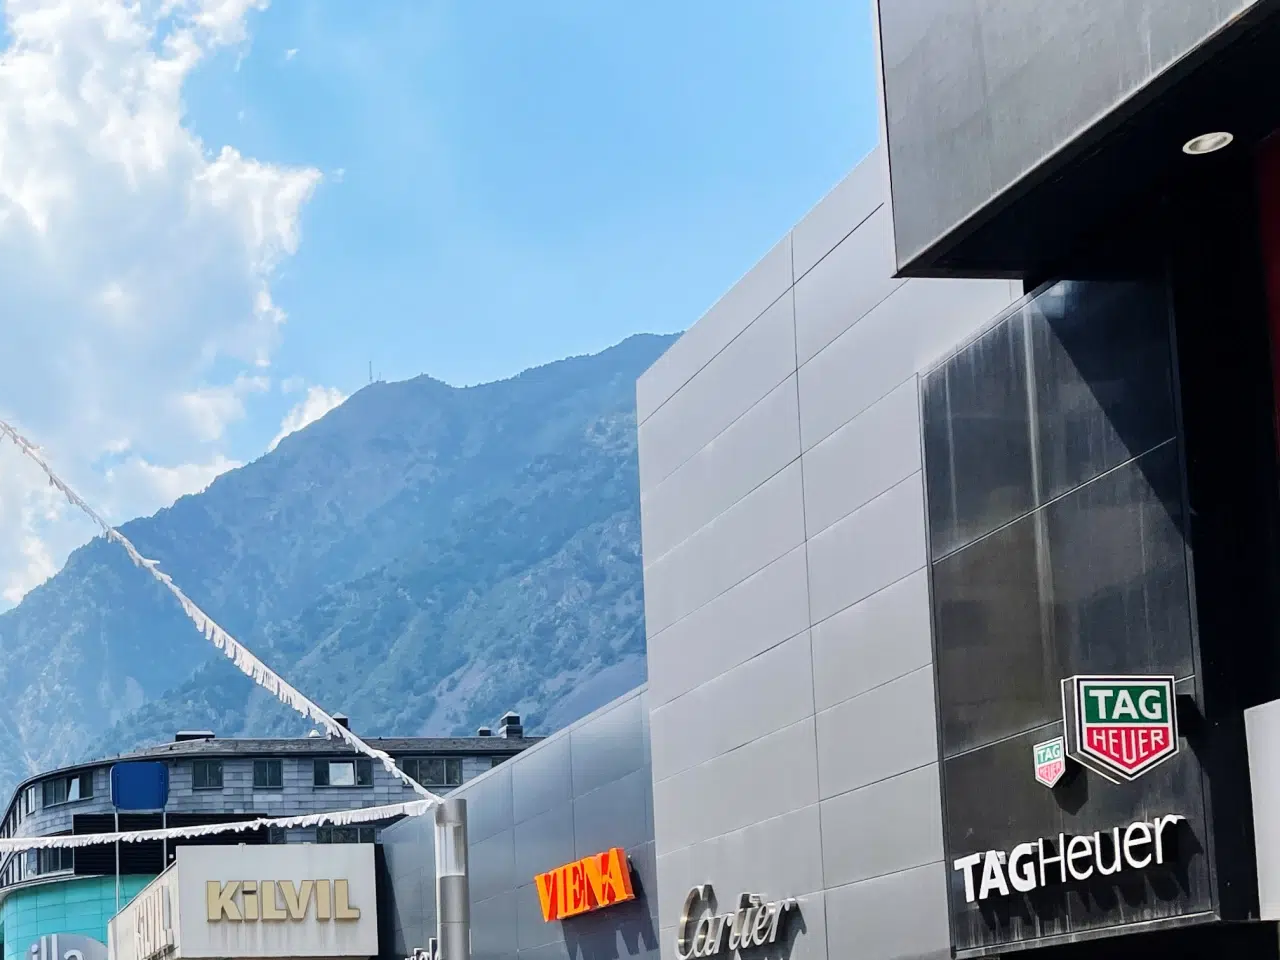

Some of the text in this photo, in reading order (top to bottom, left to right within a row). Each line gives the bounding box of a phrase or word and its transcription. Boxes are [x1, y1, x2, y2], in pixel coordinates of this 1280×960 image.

[1089, 689, 1162, 720] TAG
[1037, 745, 1061, 763] TAG
[1093, 729, 1165, 764] HEUER
[1038, 763, 1063, 783] HEUER
[534, 848, 634, 922] VIENA
[675, 884, 796, 960] Cartier
